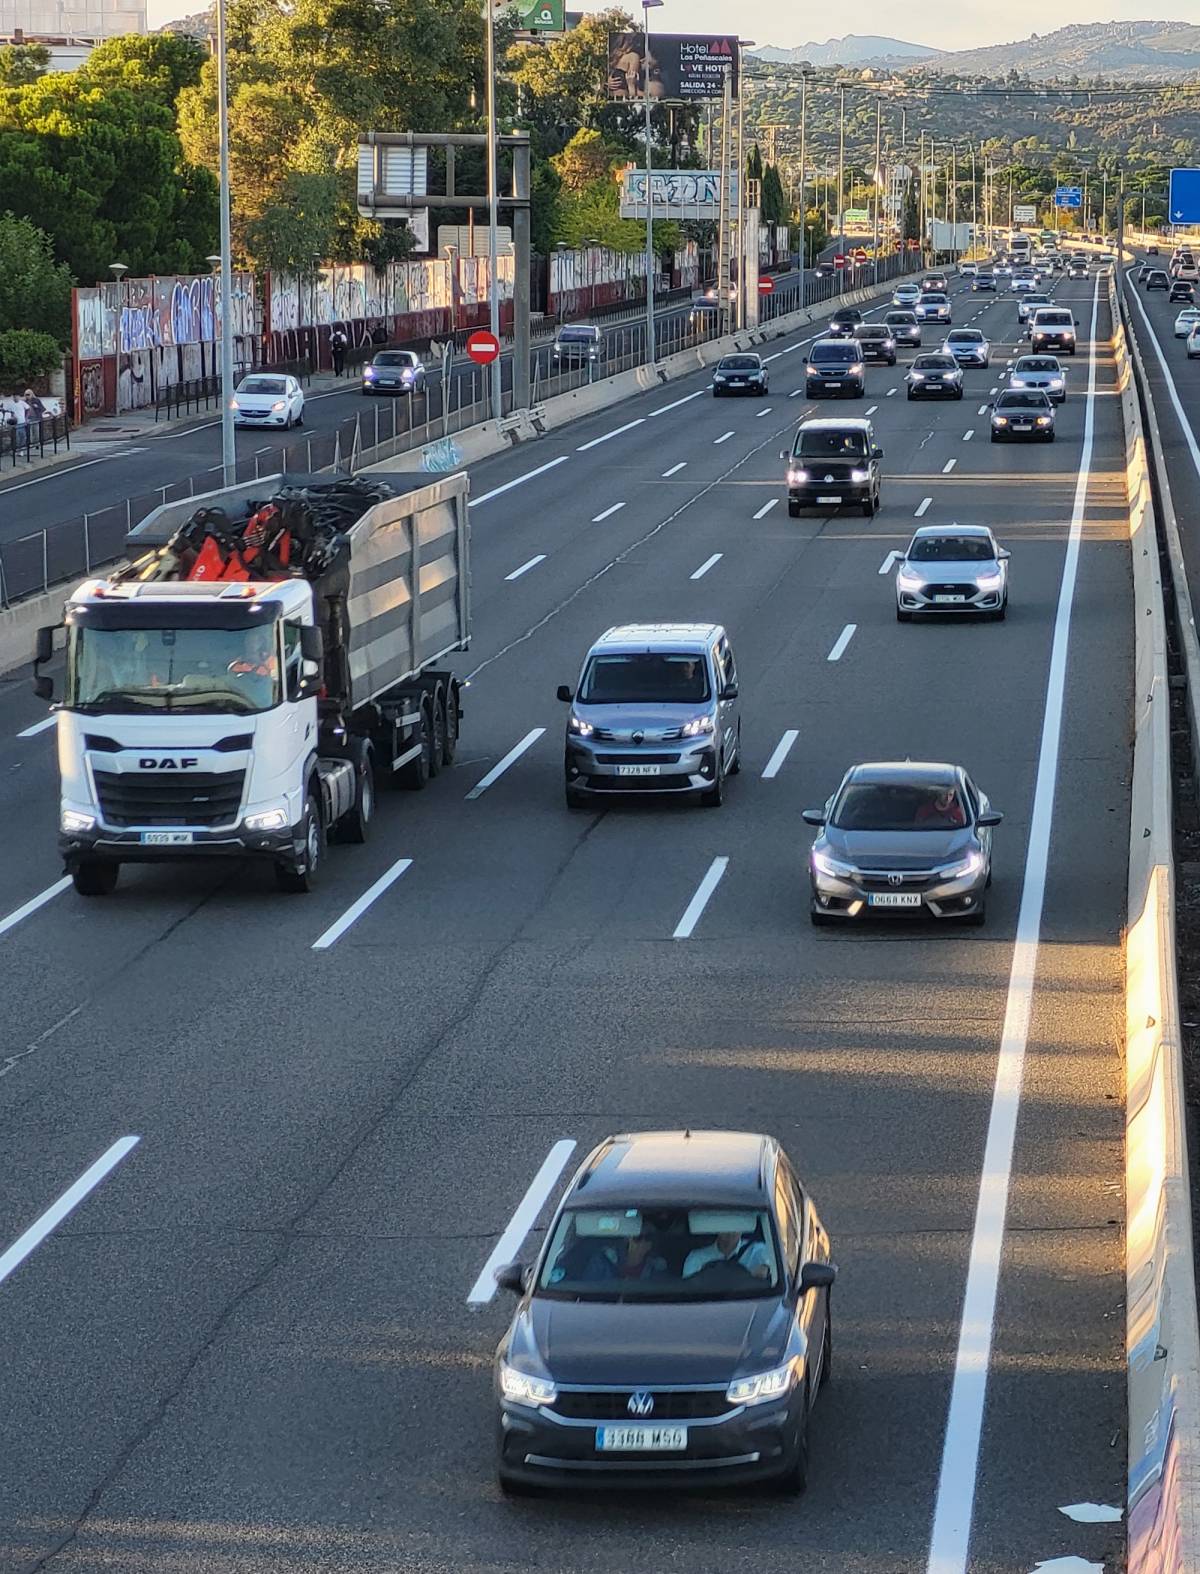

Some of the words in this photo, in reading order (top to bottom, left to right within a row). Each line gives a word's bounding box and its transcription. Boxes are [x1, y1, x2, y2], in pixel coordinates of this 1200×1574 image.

[680, 43, 709, 53] Hotel
[694, 54, 733, 62] Peñascales
[680, 64, 703, 72] LVE
[705, 64, 728, 72] HOT
[138, 758, 199, 769] DAF
